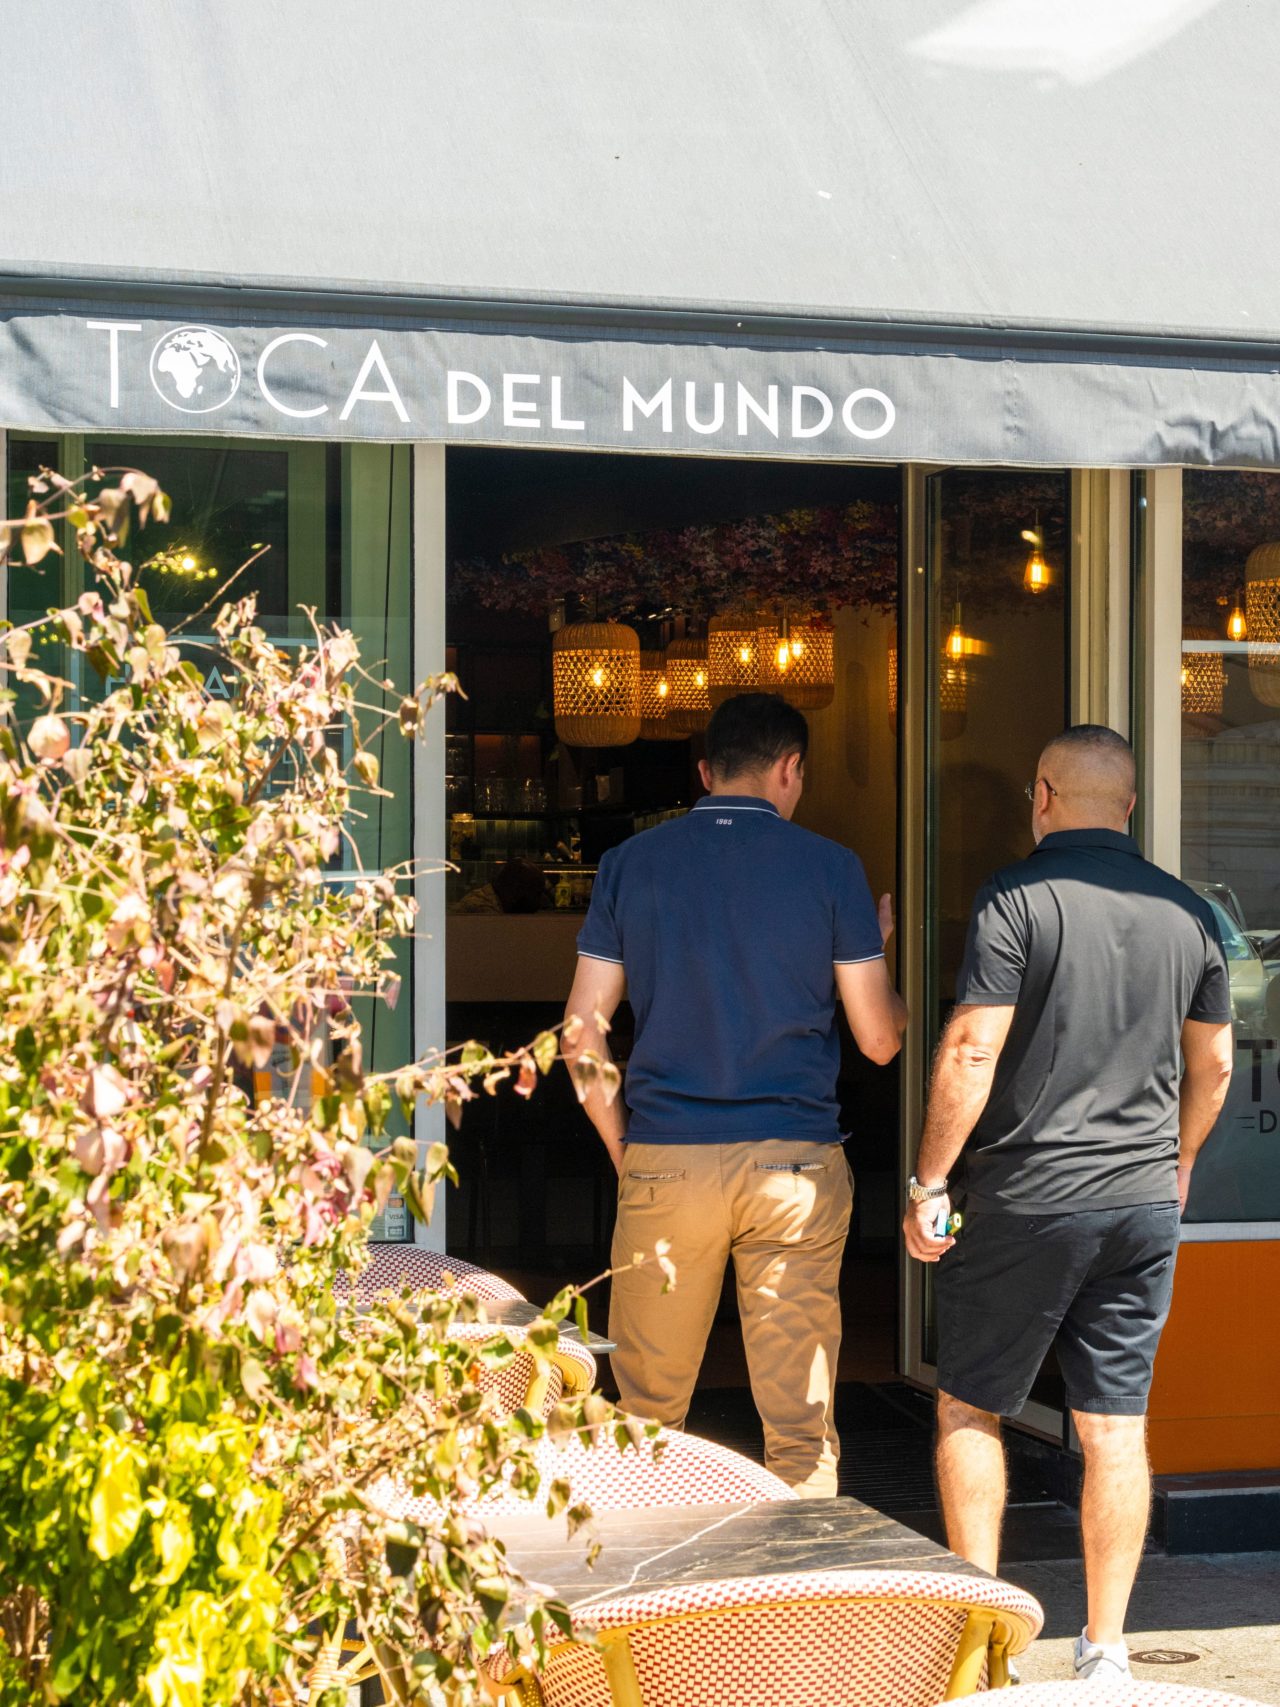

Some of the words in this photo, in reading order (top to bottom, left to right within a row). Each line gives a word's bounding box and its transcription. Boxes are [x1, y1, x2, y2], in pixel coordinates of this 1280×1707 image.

[87, 320, 411, 423] TOCA
[447, 370, 585, 430] DEL
[621, 376, 897, 440] MUNDO
